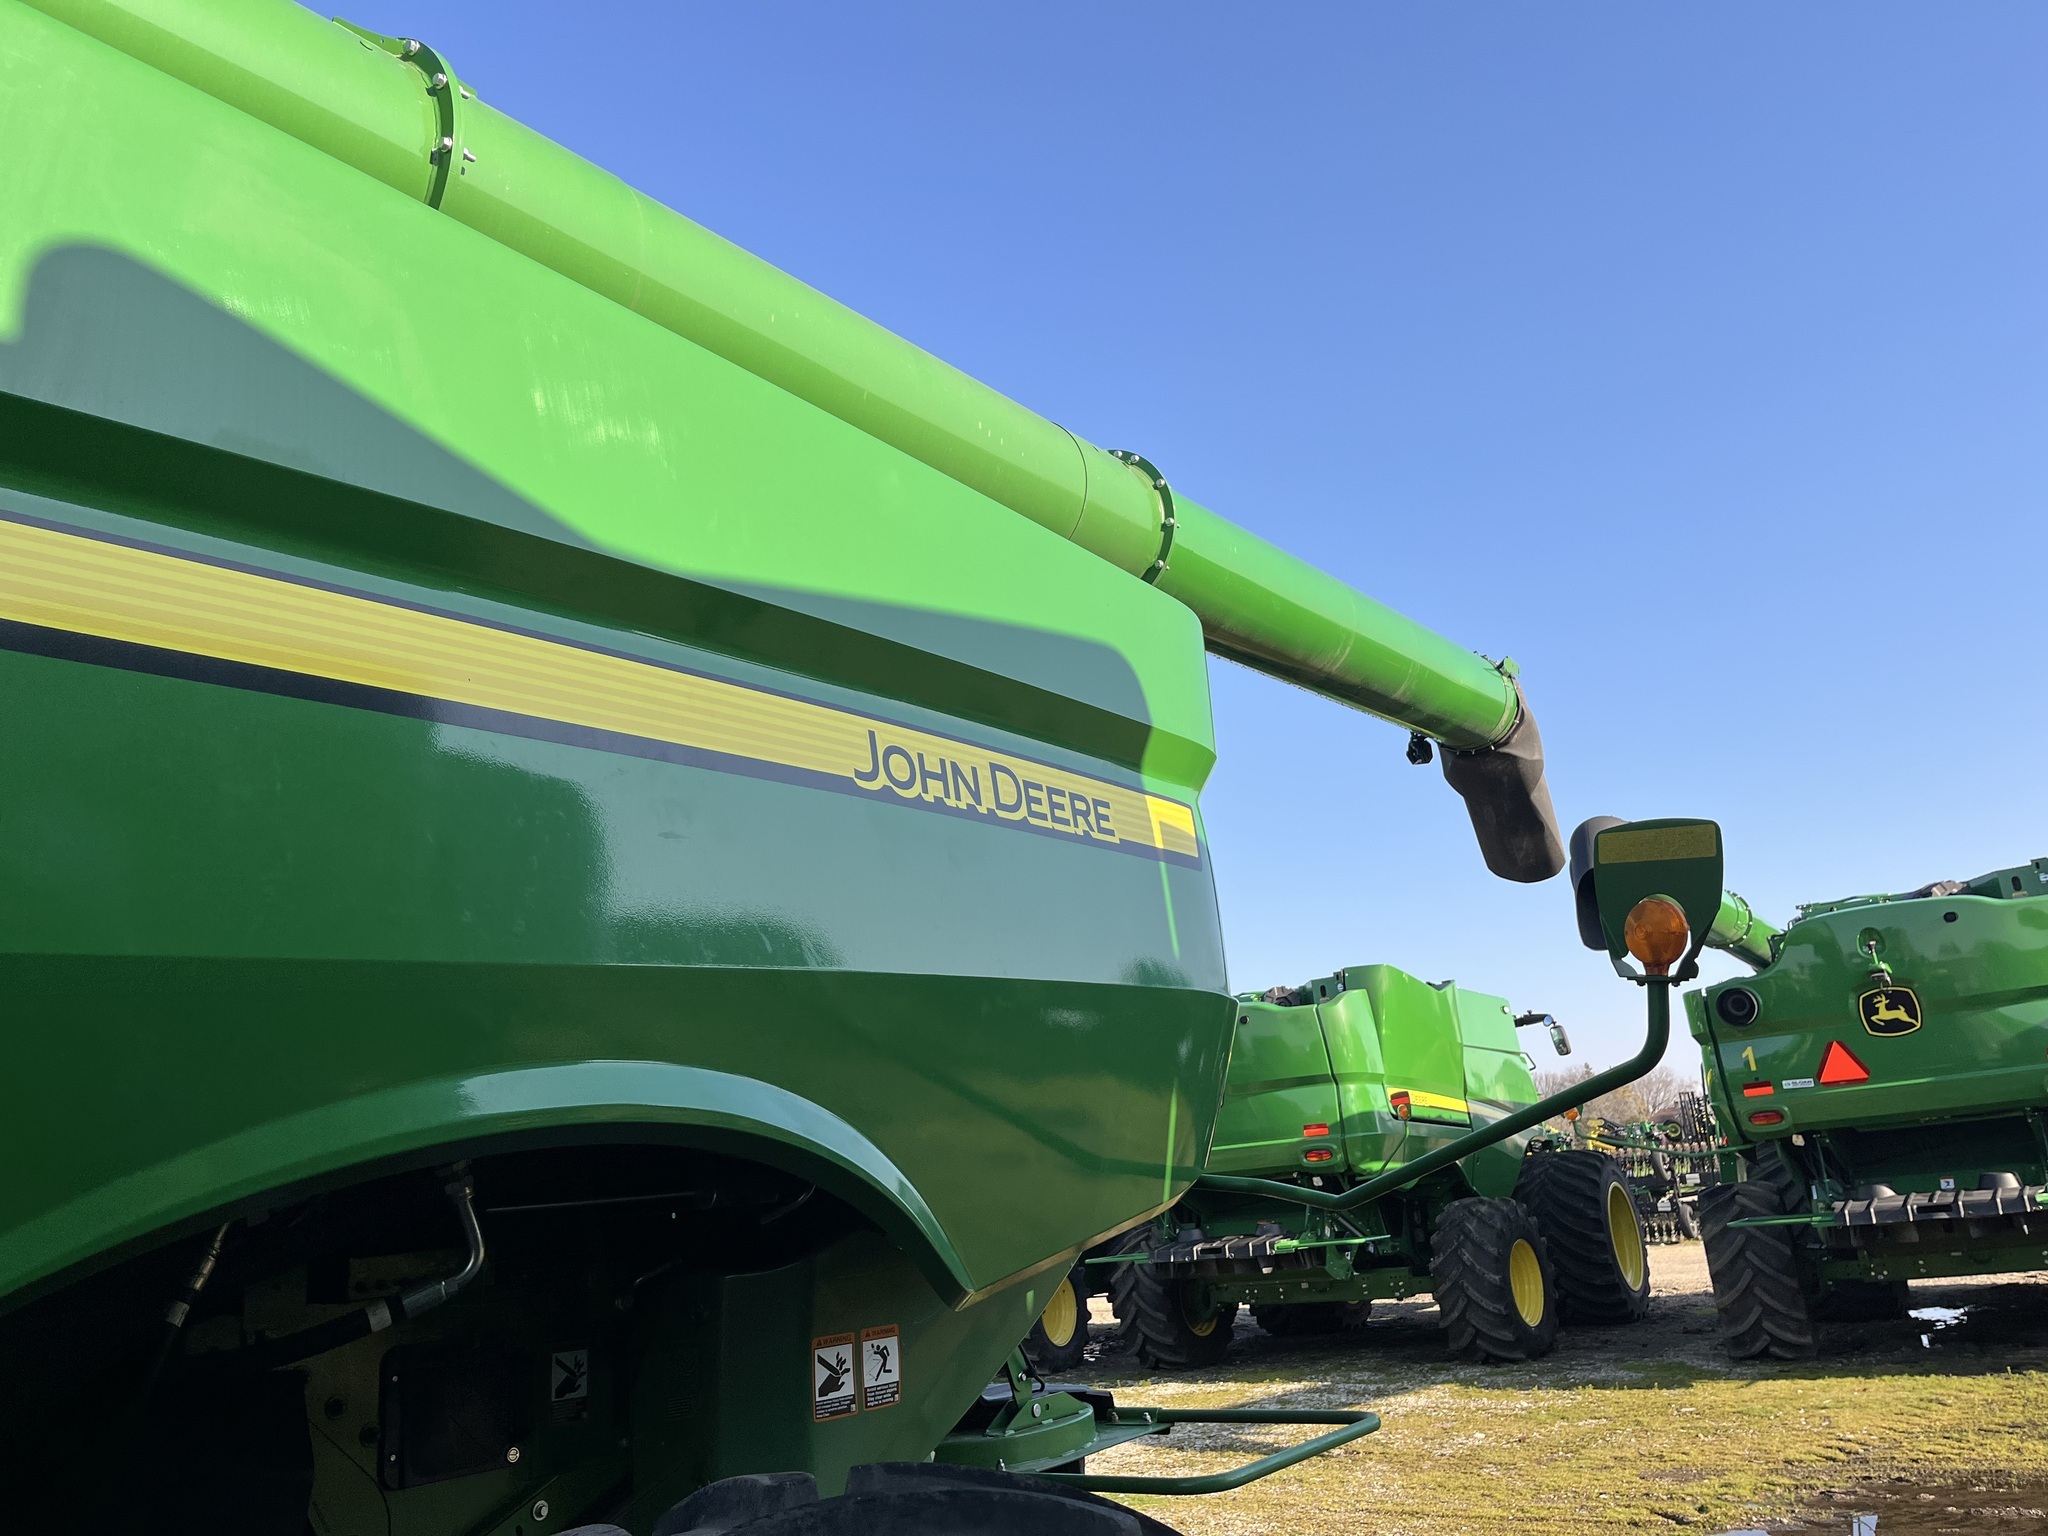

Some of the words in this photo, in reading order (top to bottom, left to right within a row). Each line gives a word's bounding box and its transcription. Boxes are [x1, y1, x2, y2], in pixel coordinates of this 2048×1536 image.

[853, 729, 983, 808] JOHN
[988, 761, 1116, 838] DEERE
[1741, 1045, 1757, 1072] 1
[823, 1335, 851, 1345] WARNING
[872, 1327, 895, 1336] WARNING
